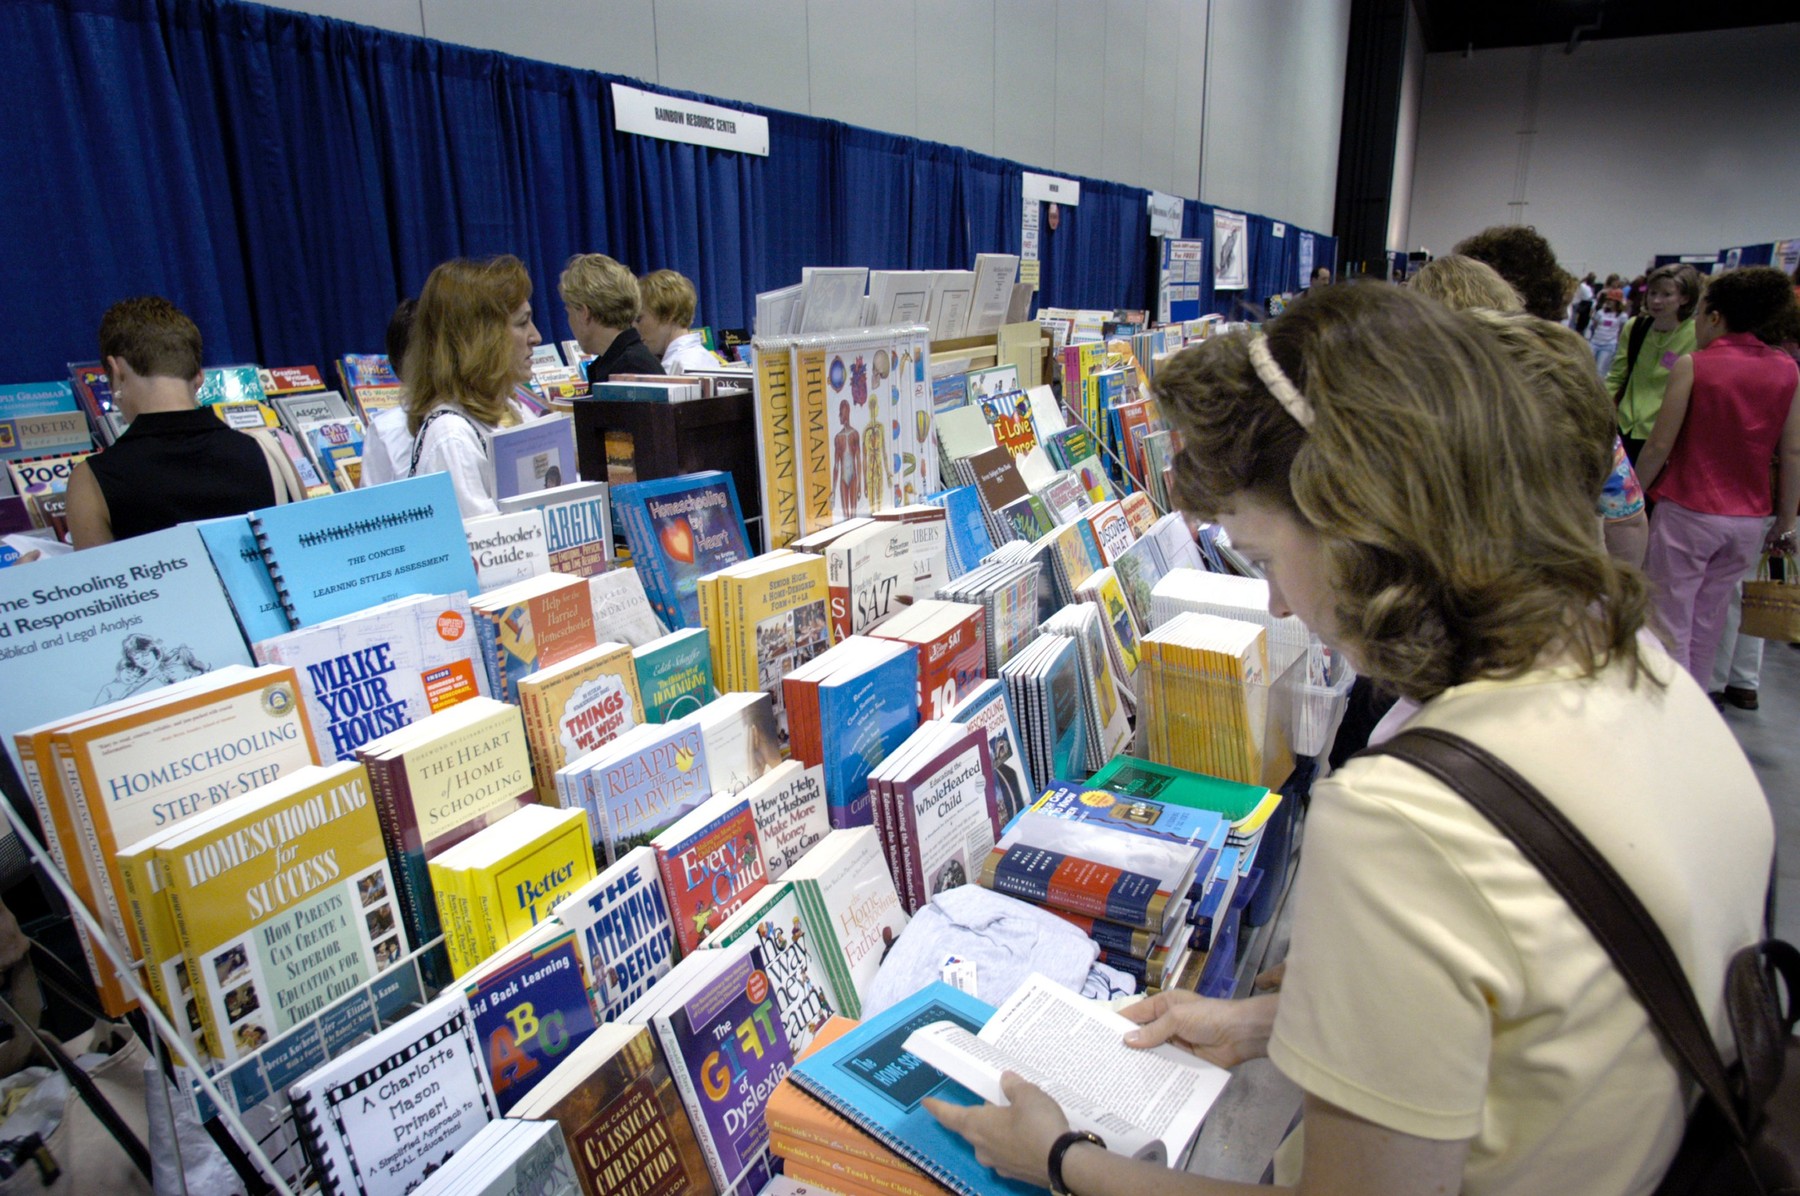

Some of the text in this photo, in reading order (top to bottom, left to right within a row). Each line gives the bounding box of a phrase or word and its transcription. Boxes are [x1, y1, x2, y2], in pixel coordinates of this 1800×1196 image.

[654, 107, 737, 134] RAINBOW RESOURCE CENTER
[16, 389, 64, 401] GRAMMAR
[21, 419, 76, 436] POETRY
[768, 370, 793, 480] HUMAN
[806, 367, 827, 480] HUMAN
[996, 418, 1031, 439] I Love
[18, 458, 76, 487] Poet
[651, 490, 727, 519] Homeschooling
[690, 517, 703, 535] by
[470, 521, 542, 553] meschooler's
[697, 530, 729, 552] Heart
[912, 526, 939, 543] UBER'S
[1098, 517, 1129, 547] DISCOVER
[1108, 535, 1129, 559] WHAT
[313, 554, 450, 598] LEARNING STYLES ASSESSMENT
[347, 545, 406, 567] THE CONCISE
[479, 548, 525, 569] Guide
[914, 558, 932, 574] SAT
[0, 555, 189, 614] me Schooling Rights
[541, 597, 561, 613] Help
[570, 589, 580, 600] the
[769, 576, 790, 591] SENIOR
[856, 574, 898, 634] SAT
[0, 588, 160, 638] d Responsibilities
[41, 633, 65, 650] and
[67, 625, 98, 643] Legal
[100, 613, 144, 635] Analysis
[537, 618, 592, 647] Homeschooler
[547, 604, 578, 627] Harried
[948, 629, 962, 650] SAT
[306, 641, 397, 696] MAKE
[426, 669, 450, 682] INSIDE
[316, 676, 394, 724] YOUR
[565, 690, 625, 738] THINGS
[931, 677, 956, 721] 10
[327, 699, 413, 756] HOUSE
[576, 712, 625, 750] WE WISH
[989, 715, 1006, 733] SCHOOL
[108, 722, 298, 801] HOMESCHOOLING
[420, 730, 512, 780] THE HEART
[605, 731, 701, 798] REAPING
[929, 759, 963, 790] Educating the
[152, 763, 281, 827] STEP-BY-STEP
[429, 769, 523, 826] SCHOOLING
[441, 757, 505, 799] of HOME
[614, 764, 705, 833] HARVEST
[649, 773, 668, 787] THE
[754, 776, 816, 816] How to Help
[914, 759, 981, 817] WholeHearted
[755, 786, 820, 831] Your Husband
[763, 804, 816, 842] Make More
[883, 792, 893, 832] Educating
[937, 792, 962, 818] Child
[183, 778, 368, 888] HOMESCHOOLING
[676, 805, 744, 852] FOCUS THE FAMILY
[775, 823, 807, 850] Money
[896, 794, 906, 832] Educating
[903, 846, 915, 897] WholeHearted
[272, 842, 299, 875] for
[384, 786, 395, 821] HEART
[396, 838, 407, 868] HOME
[403, 868, 422, 931] SCHOOLING
[679, 837, 738, 892] Every
[768, 856, 782, 872] So
[781, 844, 799, 865] You
[799, 832, 820, 851] Can
[1011, 850, 1053, 872] THE TRAINED MIND
[245, 848, 341, 920] SUCCESS
[516, 861, 574, 911] Better
[588, 866, 642, 914] THE
[711, 846, 764, 906] Child
[1007, 875, 1020, 883] THE
[263, 892, 343, 948] HOW PARENTS
[585, 877, 668, 966] ATTENTION
[729, 889, 787, 942] FOCUS FAMILY
[840, 891, 881, 936] Home
[269, 916, 347, 966] CAN CREATE A
[285, 940, 341, 981] SUPERIOR
[614, 925, 674, 993] DEFICIT
[768, 933, 813, 984] Way
[844, 922, 883, 969] Father
[276, 950, 360, 1009] EDUCATION FOR
[286, 971, 360, 1025] THEIR CHILD
[490, 955, 570, 1007] Back Learning
[489, 1001, 570, 1096] ABC
[700, 998, 778, 1102] GIFT
[712, 1020, 733, 1041] The
[360, 1048, 455, 1114] A Charlotte
[738, 1077, 750, 1094] of
[851, 1056, 878, 1073] The
[873, 1060, 910, 1088] HOME
[388, 1079, 441, 1121] Mason
[595, 1091, 644, 1136] THE CASE FOR
[721, 1060, 789, 1136] Dyslexia
[369, 1101, 473, 1178] A Simplified Approach to
[393, 1100, 449, 1142] Primer!
[583, 1097, 659, 1171] CLASSICAL
[774, 1120, 889, 1164] Beechick You Teach Your
[389, 1123, 463, 1178] REAL Education!
[594, 1119, 668, 1196] CHRISTIAN
[777, 1141, 912, 1195] Beechick You Teach Your Child
[792, 1173, 825, 1191] Beechick
